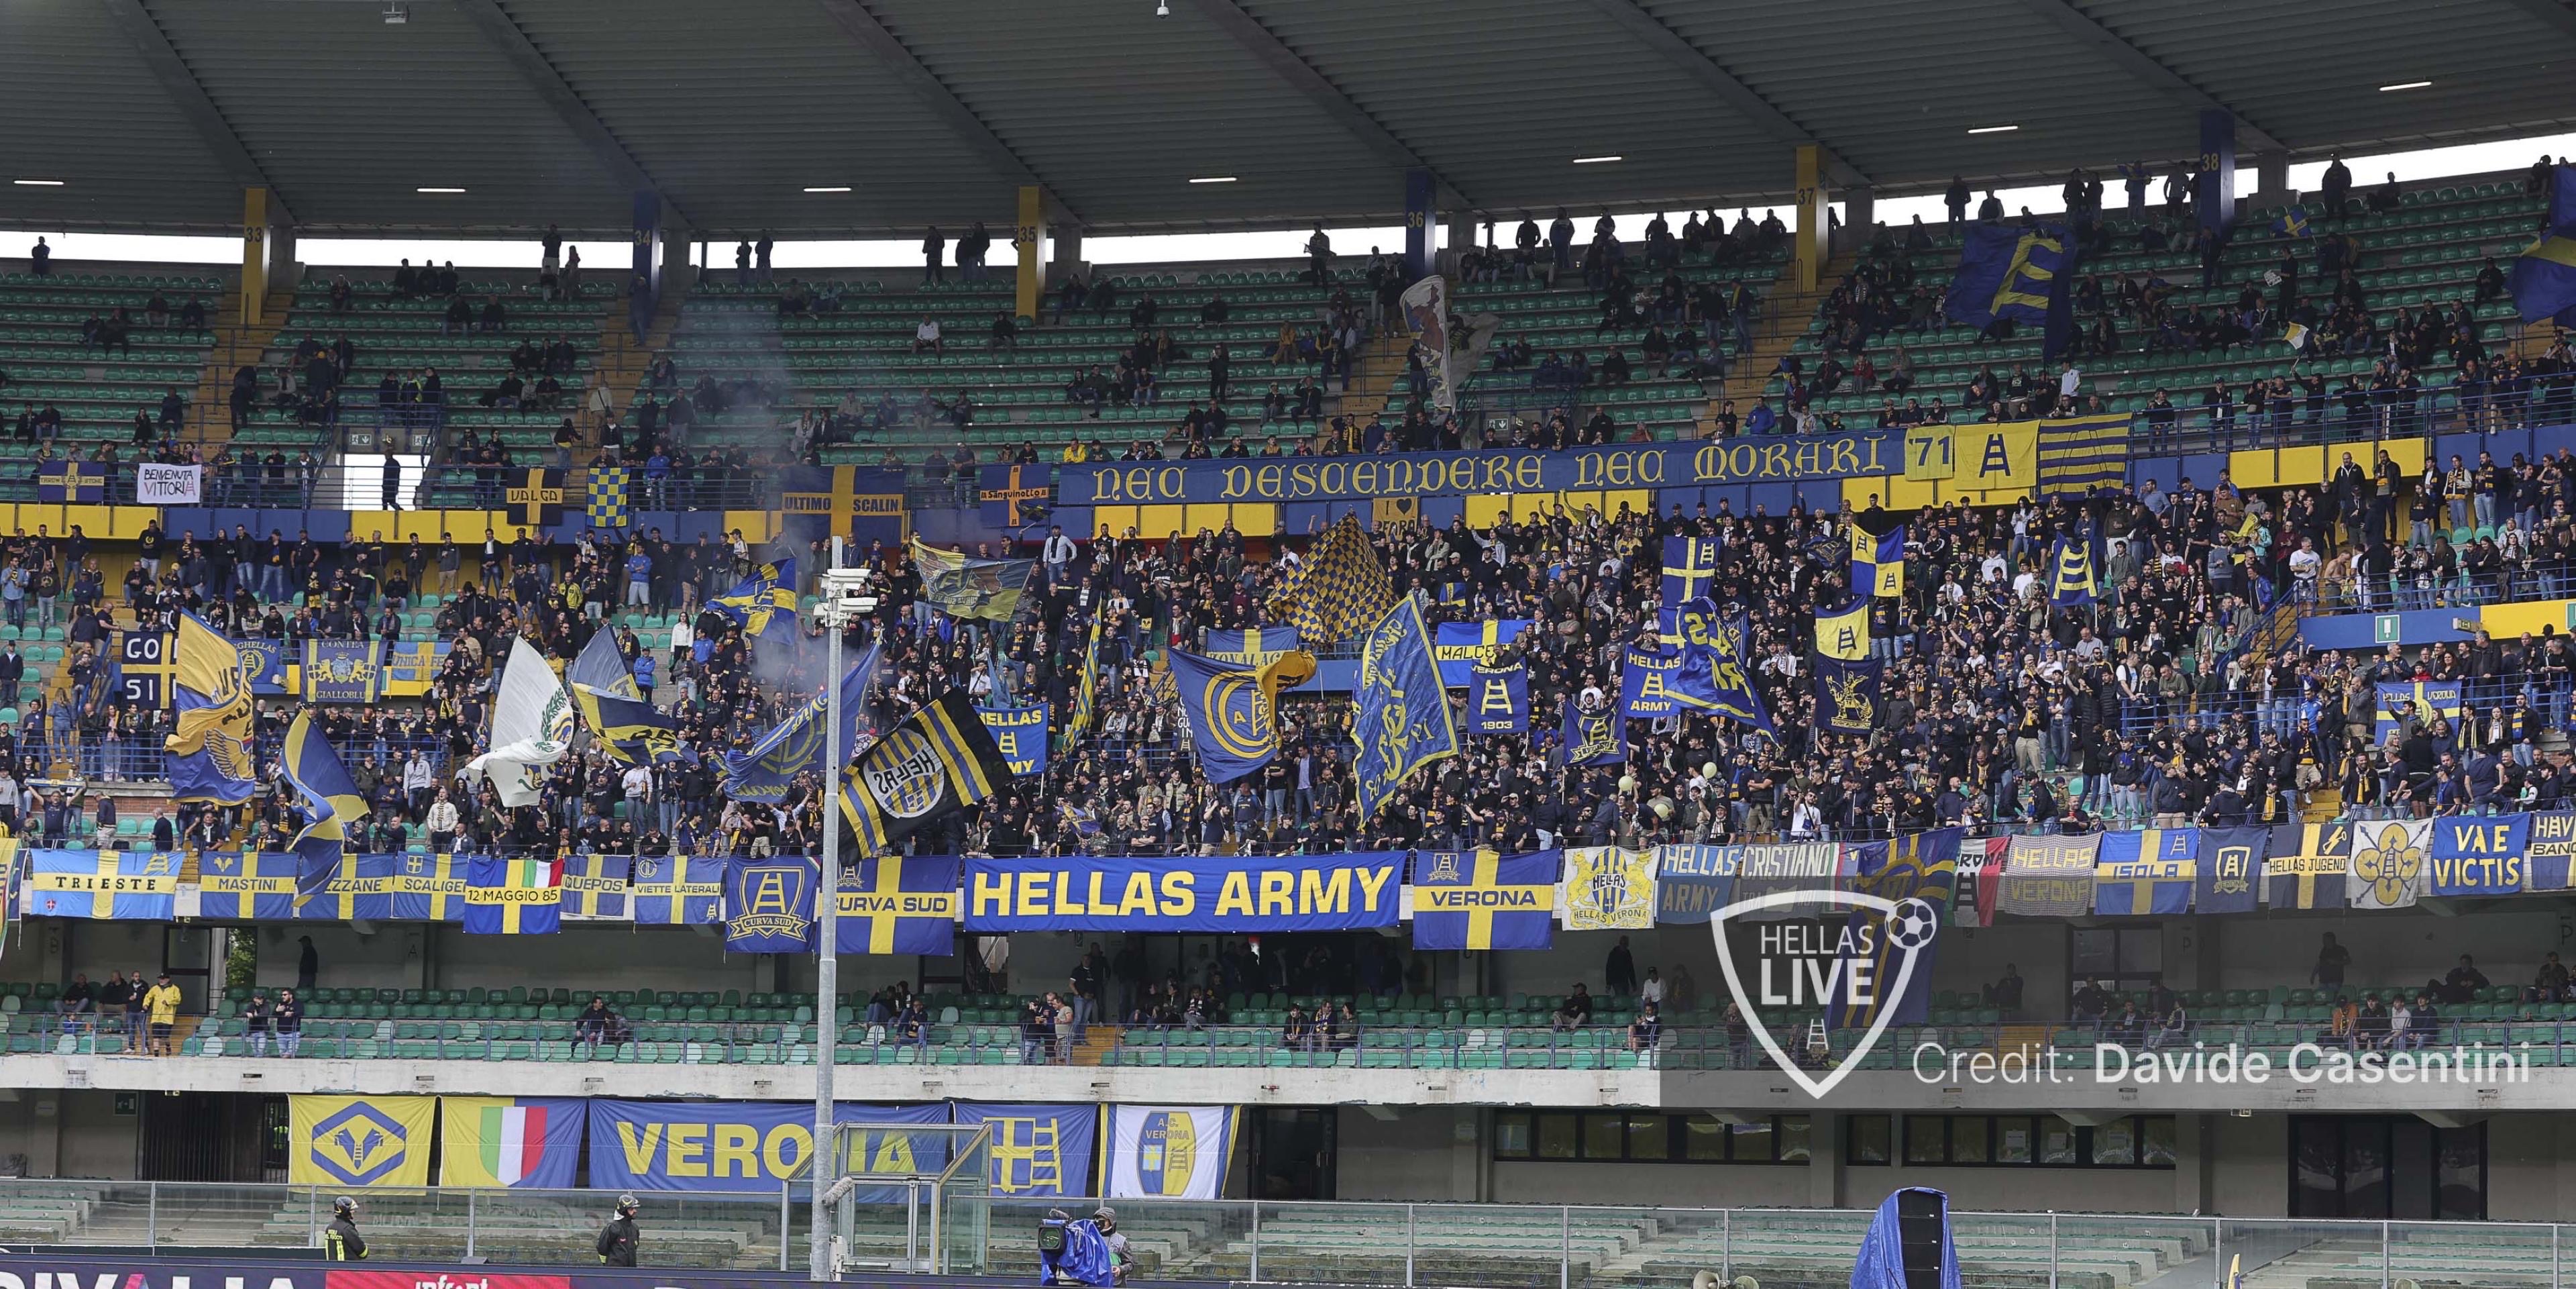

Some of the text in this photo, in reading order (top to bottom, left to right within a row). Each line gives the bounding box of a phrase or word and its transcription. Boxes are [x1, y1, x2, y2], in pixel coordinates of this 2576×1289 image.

[2202, 154, 2218, 171] 38
[1799, 188, 1815, 204] 37
[1409, 211, 1423, 227] 36
[246, 227, 262, 242] 33
[635, 229, 651, 246] 34
[1020, 227, 1036, 242] 35
[1693, 433, 1887, 482] MORARI
[144, 468, 193, 480] BENVENUTA
[144, 481, 196, 497] VITTORIA
[784, 497, 899, 513] ULTIMO SCALIN
[321, 640, 364, 650] CONTEA
[1442, 643, 1511, 659] MALCE
[392, 654, 445, 667] UNICA FE
[1470, 662, 1523, 674] VERONA
[1628, 652, 1681, 670] HELLAS
[316, 690, 366, 699] GIALLOBLU
[1630, 700, 1671, 712] ARMY
[1481, 721, 1513, 730] 1903
[1006, 759, 1035, 774] MY
[2454, 824, 2510, 854] VAE
[1663, 845, 1740, 877] HELLAS
[1741, 843, 1830, 881] CRISTIANO
[2013, 846, 2093, 869] HELLAS
[2269, 856, 2346, 873] HELLAS JUGEND
[2113, 864, 2178, 880] ISOLA
[2434, 856, 2521, 888] VICTIS
[55, 876, 156, 890] TRIESTE
[218, 879, 277, 892] MASTINI
[565, 875, 623, 892] QUEPOS
[637, 885, 720, 893] VIETTE LATERALI
[1593, 874, 1626, 890] HELLAS
[468, 890, 558, 901] 12 MAGGIO 85
[972, 866, 1394, 917] HELLAS ARMY
[1430, 890, 1536, 907] VERONA
[1662, 882, 1720, 913] ARMY
[2012, 880, 2090, 903] VERONA
[836, 896, 947, 912] URVA SUD
[744, 917, 792, 927] CURVA SUD
[1574, 909, 1647, 923] HELLAS VERONA
[1158, 1118, 1179, 1128] A.C.
[1145, 1129, 1191, 1140] VERONA
